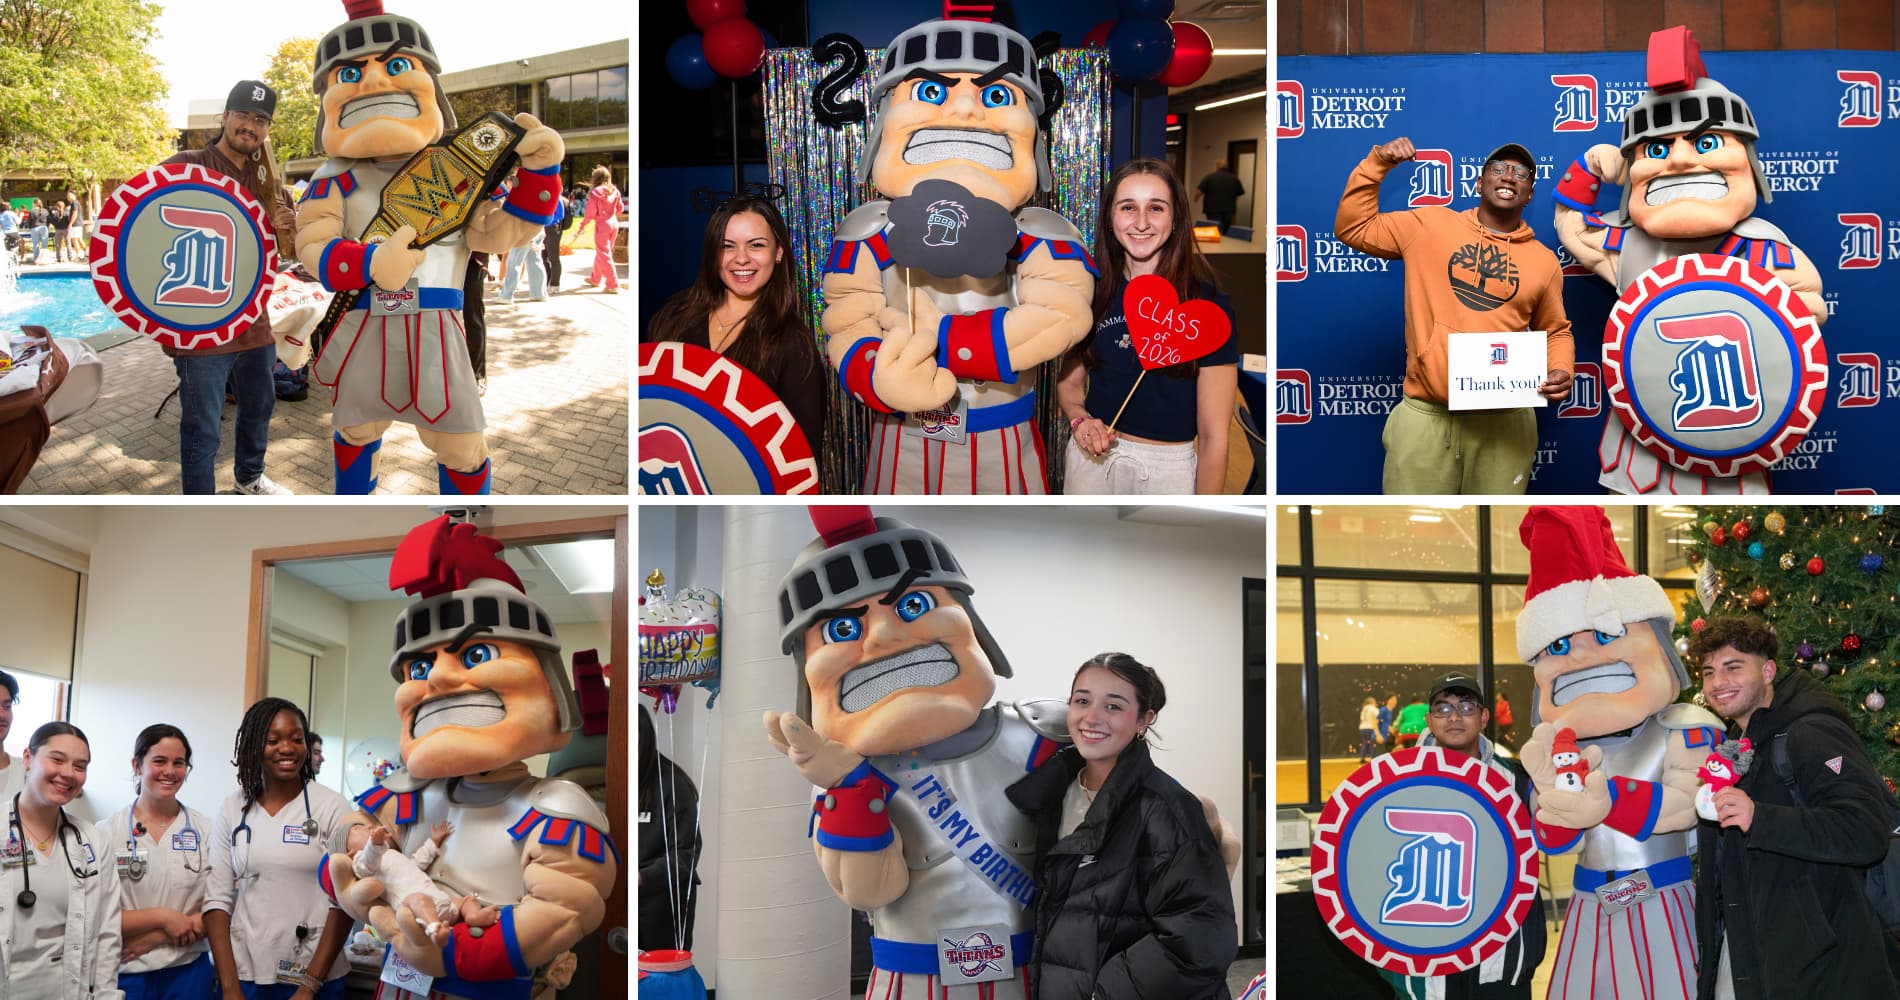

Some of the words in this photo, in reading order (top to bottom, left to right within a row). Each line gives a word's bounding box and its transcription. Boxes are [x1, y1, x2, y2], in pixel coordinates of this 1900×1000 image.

[1311, 95, 1406, 112] DETROIT
[1311, 112, 1389, 129] MERCY
[1764, 176, 1822, 192] ERCY
[1315, 257, 1390, 273] MERCY
[375, 290, 415, 303] TITANS
[1138, 296, 1201, 340] CLASS
[1153, 332, 1171, 343] of
[1138, 337, 1181, 366] 2026
[1455, 376, 1506, 391] Thank
[1510, 375, 1541, 393] you!
[1318, 400, 1394, 416] MERCY
[1769, 455, 1820, 471] ERCY
[638, 629, 705, 660] HAPPY
[638, 656, 713, 683] IRTHDAY!
[939, 810, 981, 850] MY
[944, 944, 1005, 966] TITANS
